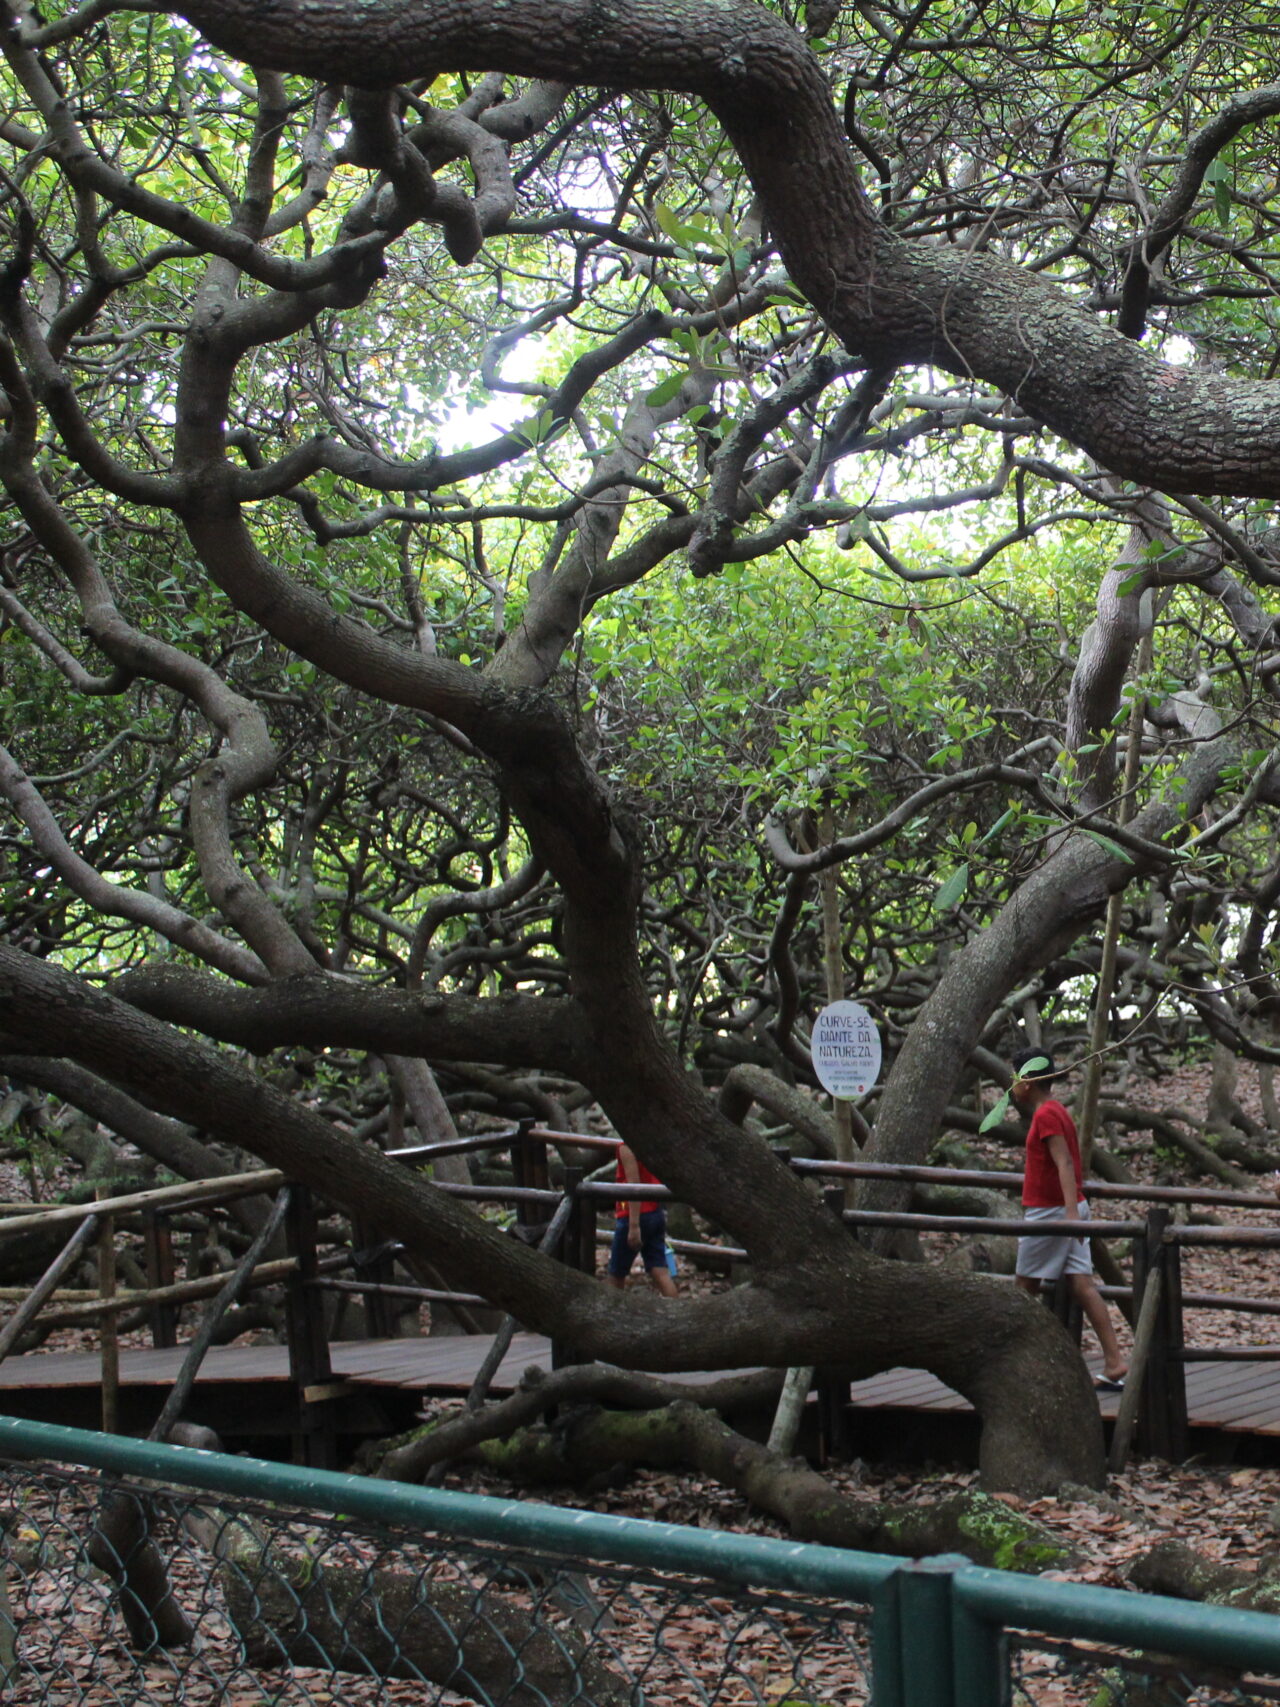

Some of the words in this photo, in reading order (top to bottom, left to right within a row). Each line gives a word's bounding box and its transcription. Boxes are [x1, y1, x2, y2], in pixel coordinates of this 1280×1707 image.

[820, 1015, 870, 1028] CURVE-SE
[820, 1031, 854, 1043] DIANTE
[858, 1031, 871, 1043] DA
[819, 1046, 873, 1058] NATUREZA.
